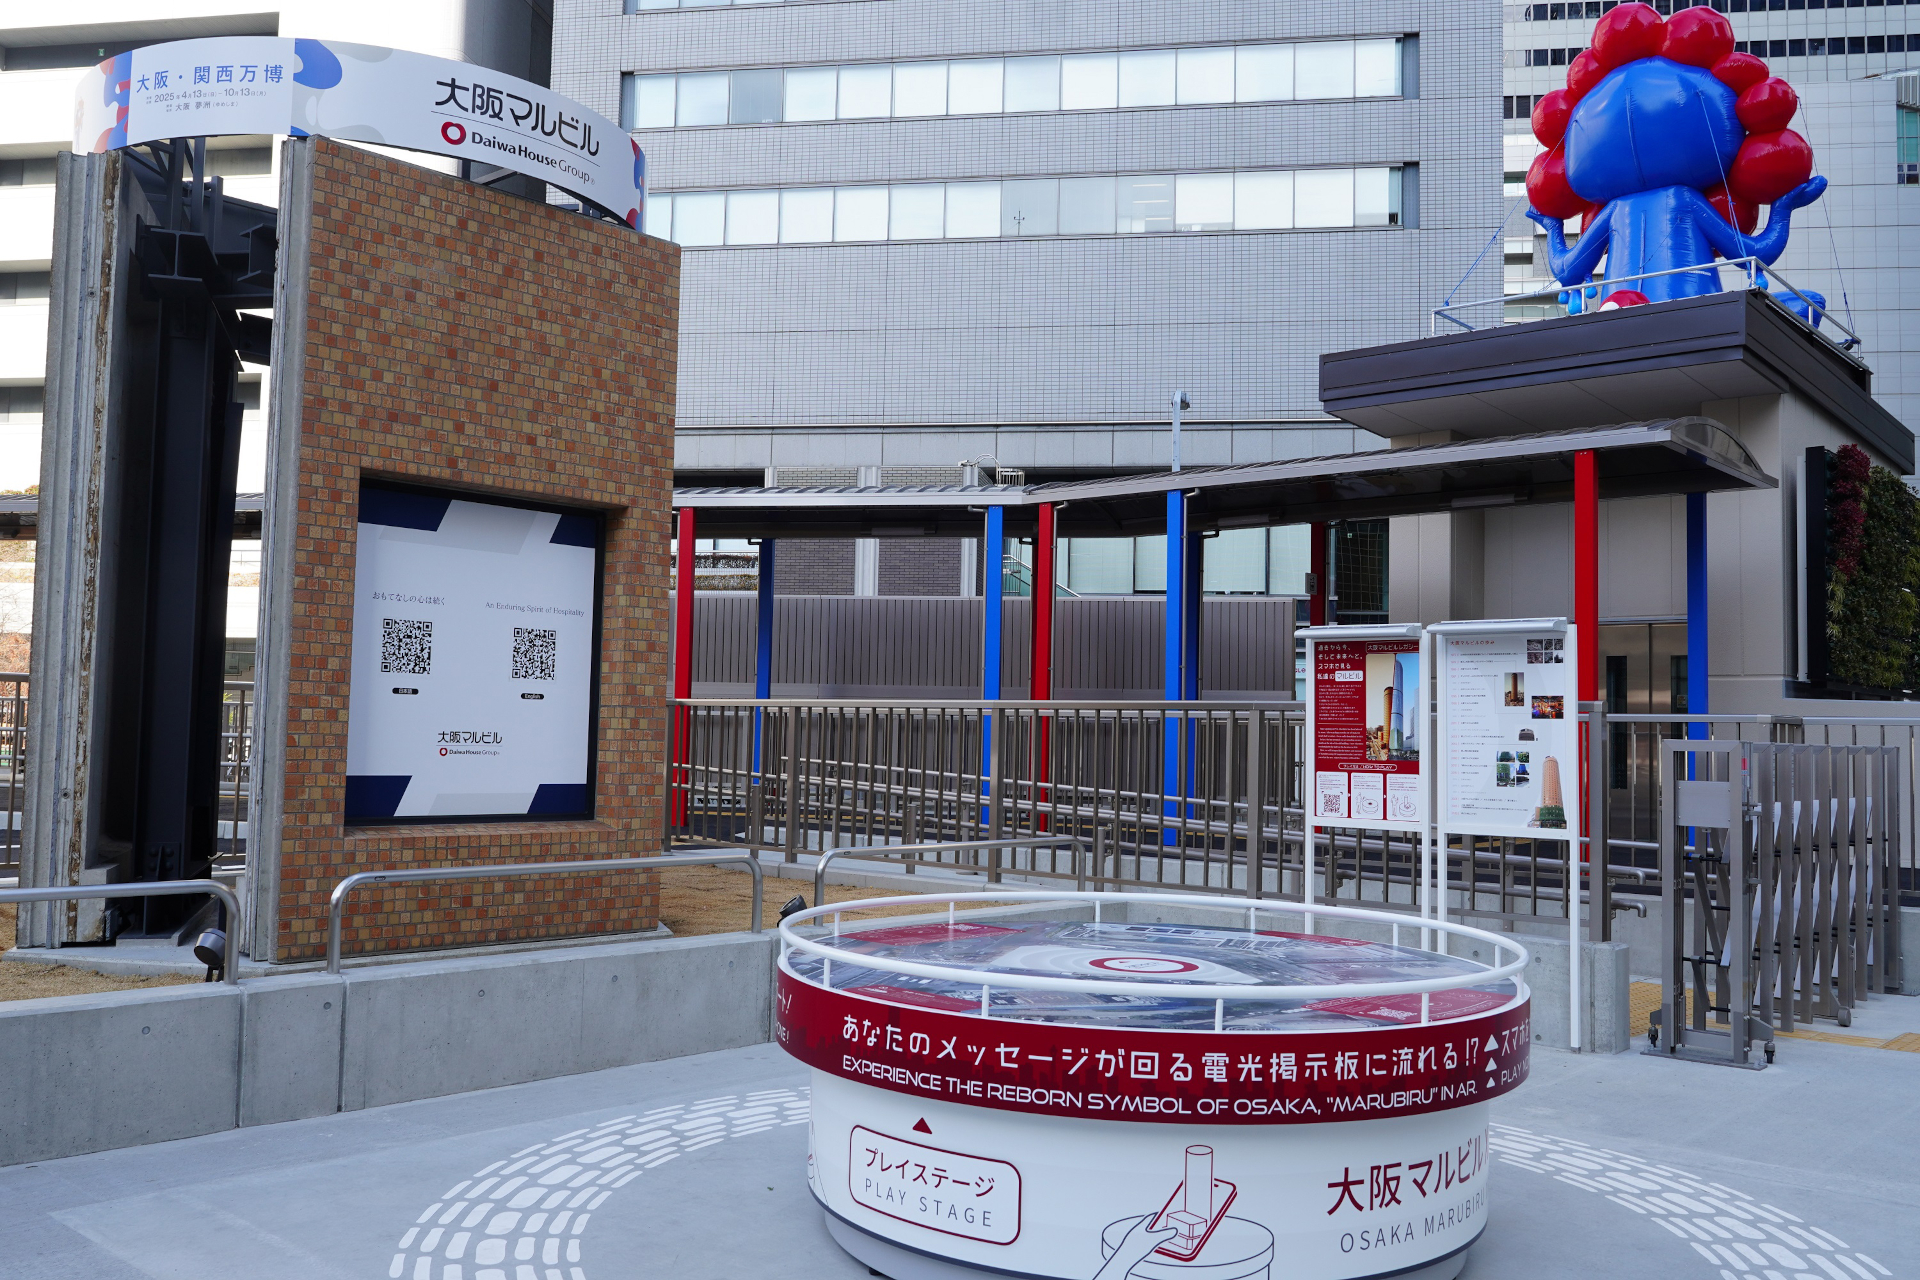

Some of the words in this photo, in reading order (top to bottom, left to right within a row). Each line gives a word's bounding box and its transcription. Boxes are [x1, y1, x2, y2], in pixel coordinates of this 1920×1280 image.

[136, 63, 284, 94] 大阪・関西万博
[434, 77, 600, 157] 大阪マルビル
[372, 591, 445, 606] おもてなしの心は続く
[496, 602, 525, 613] Enduring
[526, 604, 544, 614] Spirit
[553, 607, 585, 618] Hospitality
[437, 730, 503, 744] 大阪マルビル
[842, 1054, 942, 1091] EXPERIENCE
[945, 1076, 983, 1097] THE
[987, 1083, 1083, 1109] REBORN
[1087, 1095, 1192, 1115] SYMBOL
[1196, 1098, 1229, 1115] OF
[1233, 1096, 1321, 1116] OSAKA,
[1326, 1086, 1439, 1113] "MARUBIRU"
[1440, 1083, 1455, 1101] IN
[1455, 1080, 1478, 1098] AR.
[1501, 1062, 1522, 1086] PLAY
[865, 1147, 995, 1198] プレイステージ
[865, 1177, 907, 1206] PLAY
[918, 1196, 992, 1228] STAGE
[1340, 1221, 1415, 1253] OSAKA
[1424, 1187, 1485, 1236] MARUBIRU
